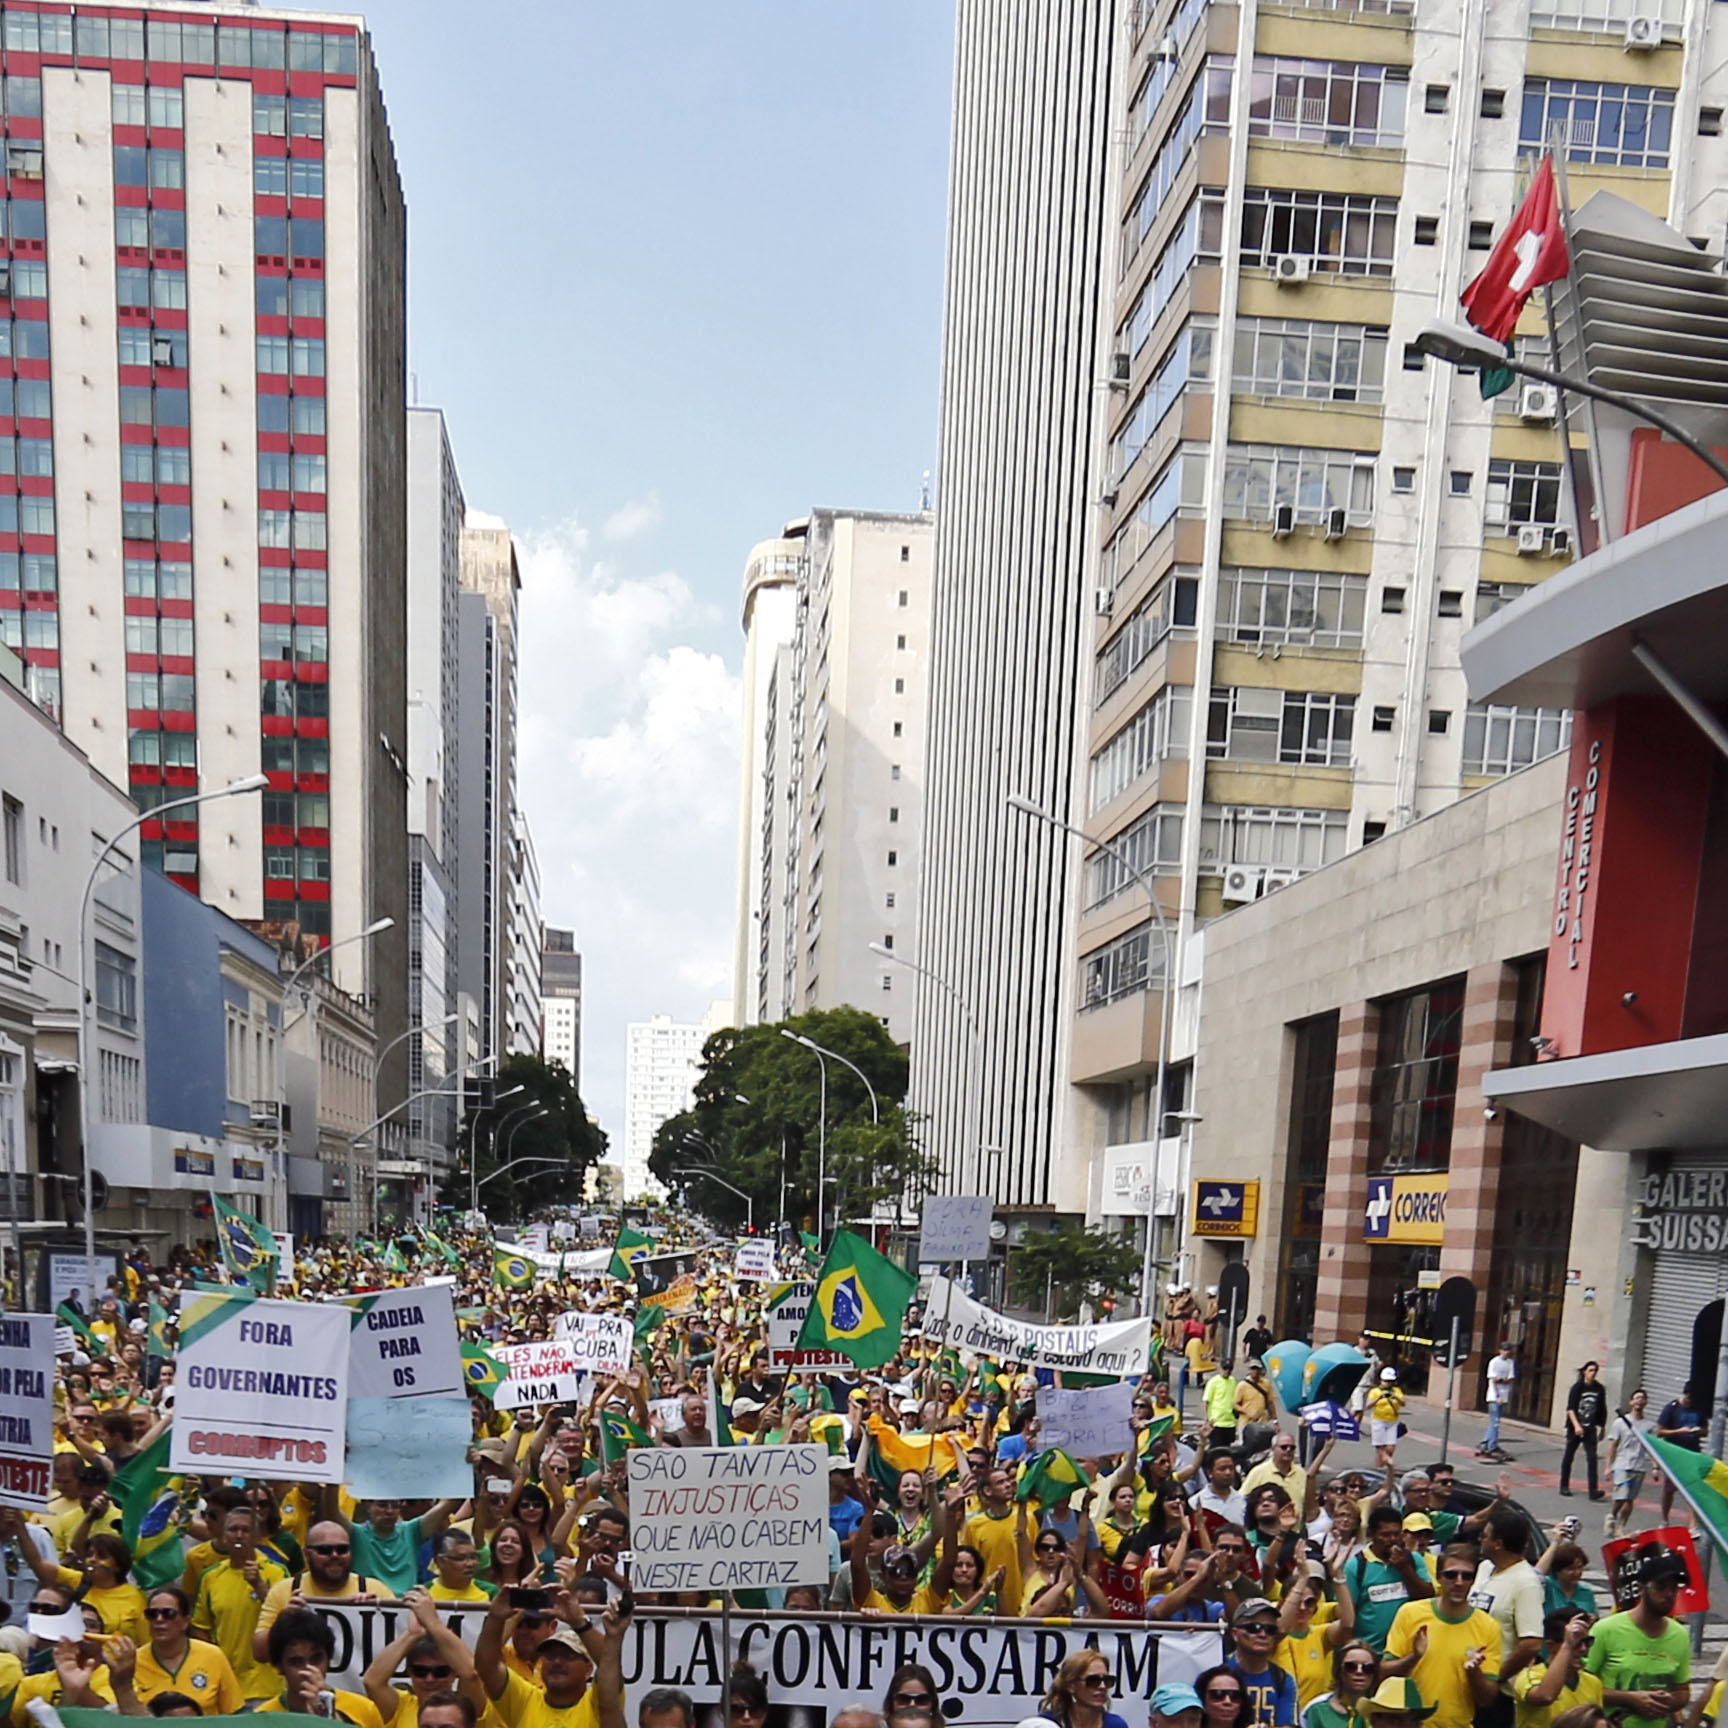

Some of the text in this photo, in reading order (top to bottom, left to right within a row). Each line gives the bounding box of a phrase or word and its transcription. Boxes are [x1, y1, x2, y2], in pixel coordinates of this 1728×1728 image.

[1555, 786, 1580, 936] CENTRO
[1567, 740, 1602, 970] COMERCIAL
[1196, 1221, 1241, 1233] CORREIOS
[367, 1305, 425, 1332] CADEIA
[564, 1317, 622, 1337] VAI PRA
[240, 1320, 293, 1347] FORA
[379, 1336, 422, 1360] PARA
[573, 1337, 618, 1359] CUBA
[14, 1369, 45, 1399] PELA
[188, 1365, 338, 1401] GOVERNANTES
[393, 1367, 416, 1388] OS
[518, 1384, 559, 1402] NADA
[189, 1430, 327, 1465] CORRUPTOS
[630, 1448, 817, 1481] SÃO TANTAS
[640, 1483, 800, 1517] INJUSTIÇAS
[633, 1518, 823, 1554] QUE NÃO CABEM
[634, 1561, 800, 1589] NESTE CARTAZ
